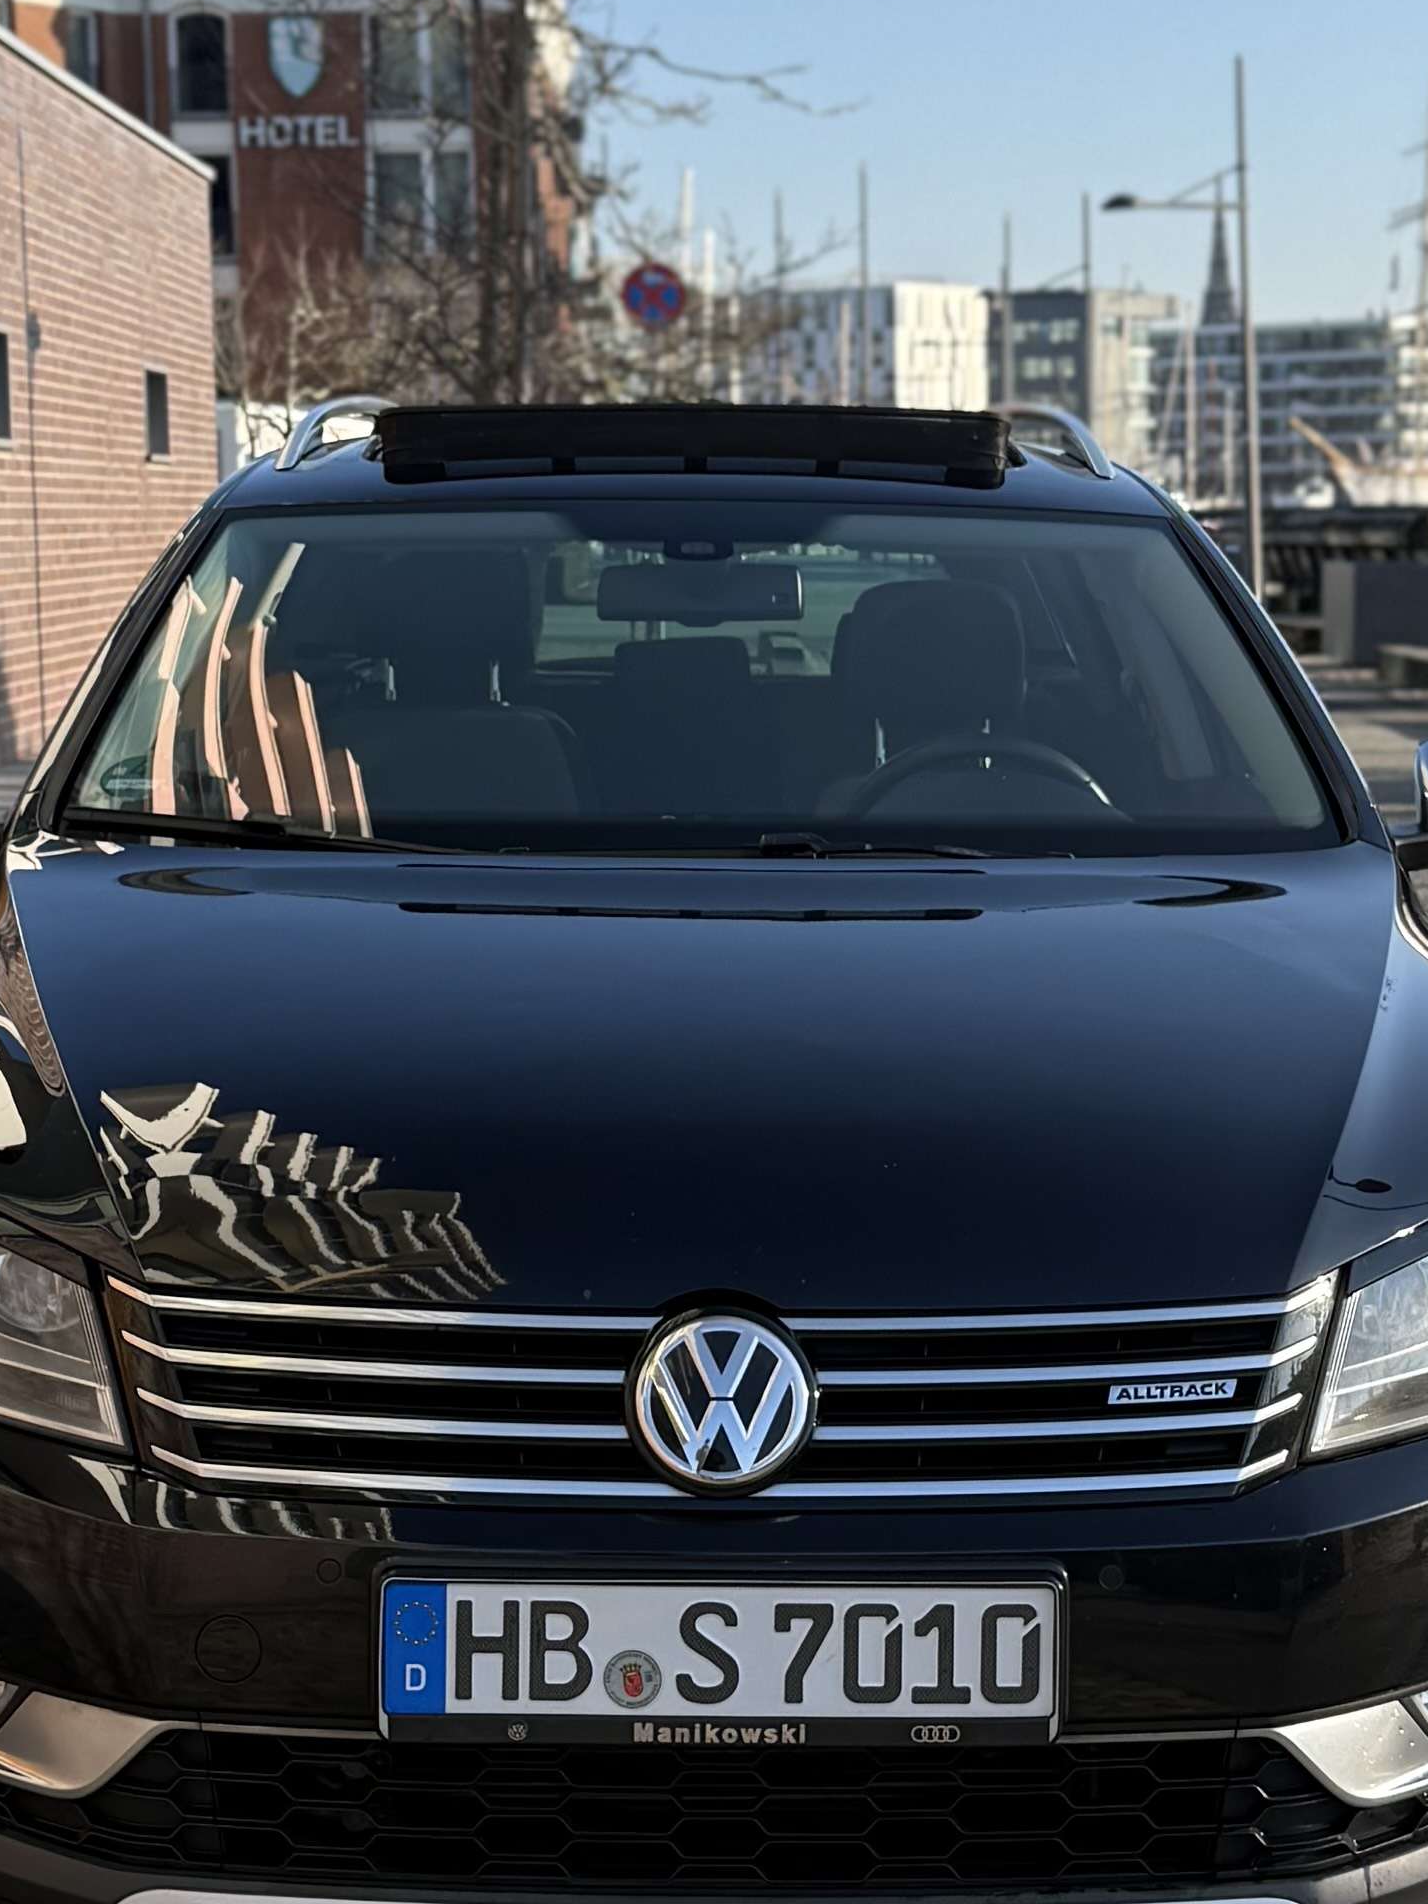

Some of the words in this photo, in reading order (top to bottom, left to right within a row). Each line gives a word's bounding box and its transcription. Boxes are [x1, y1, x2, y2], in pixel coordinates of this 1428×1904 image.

[238, 114, 359, 148] HOTEL
[1116, 1382, 1228, 1400] ALLTRACK
[454, 1599, 593, 1701] HB
[675, 1601, 739, 1704] S
[774, 1603, 1041, 1705] 7010
[405, 1663, 426, 1691] D
[633, 1722, 807, 1744] Manikowski
